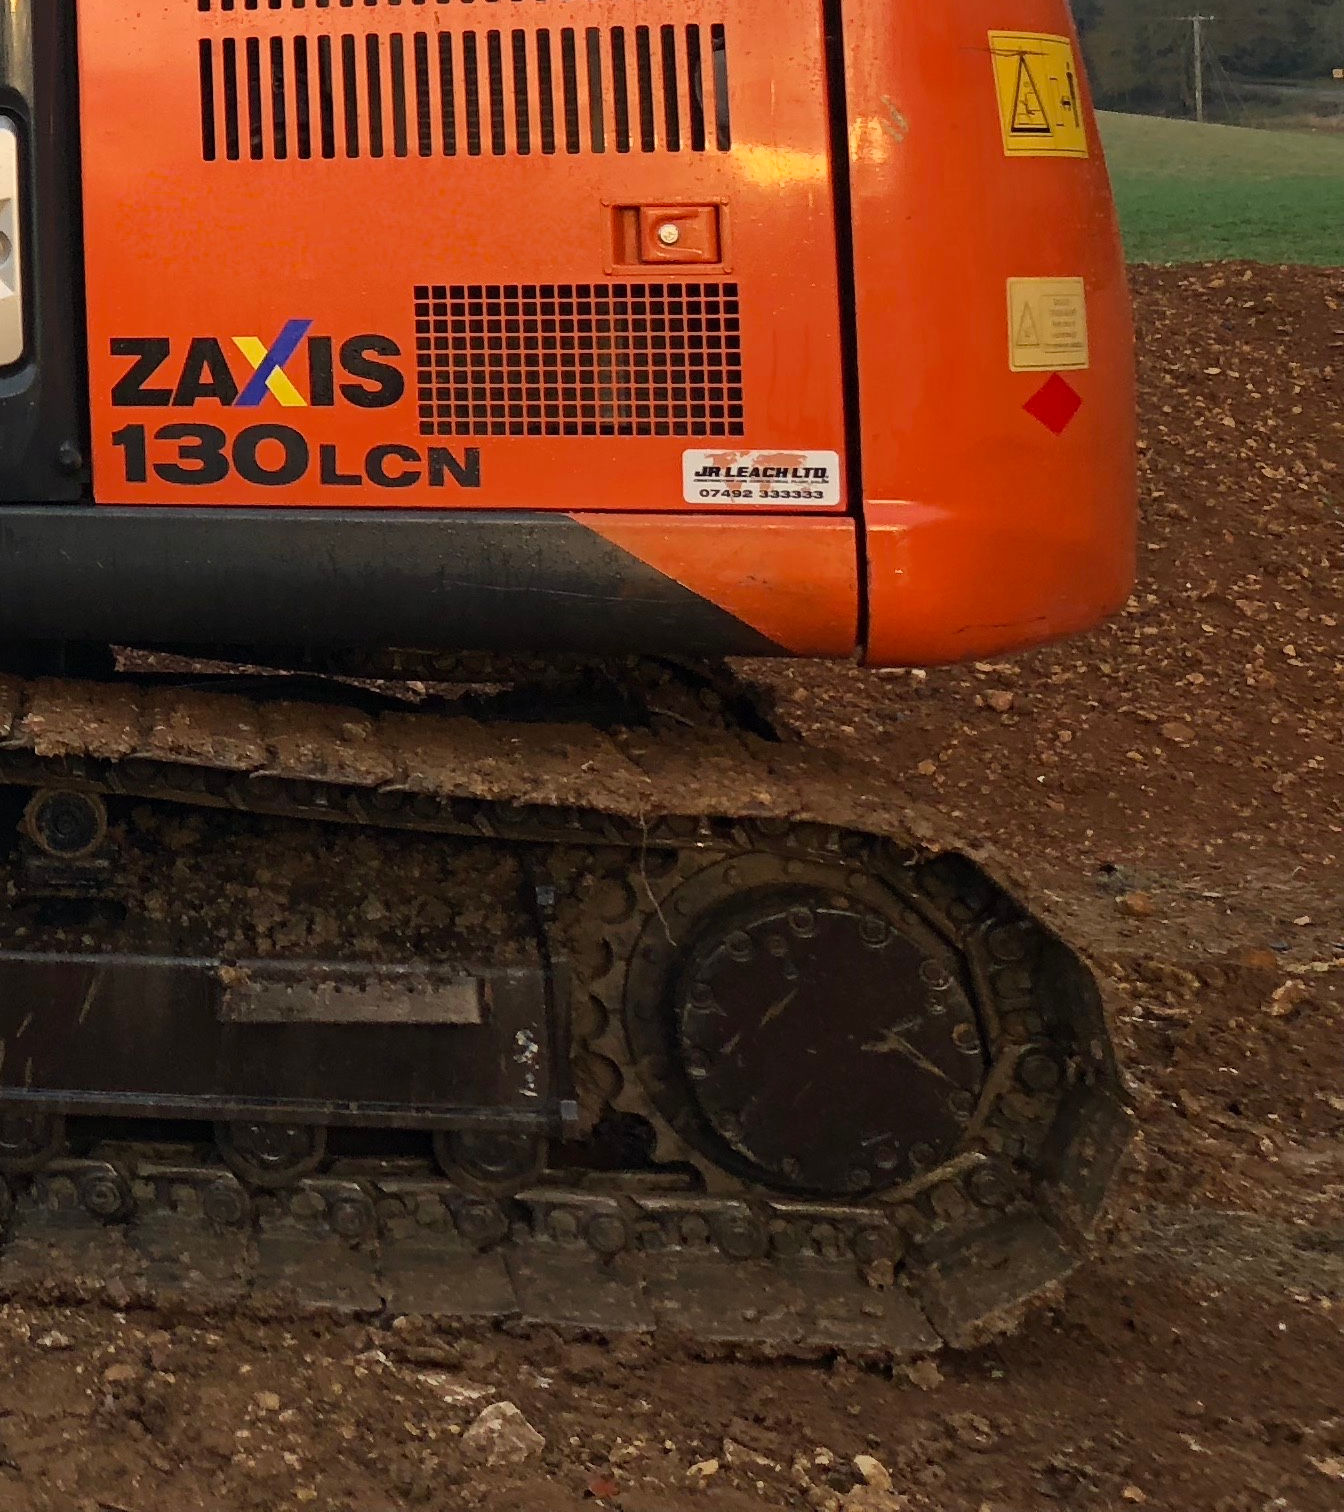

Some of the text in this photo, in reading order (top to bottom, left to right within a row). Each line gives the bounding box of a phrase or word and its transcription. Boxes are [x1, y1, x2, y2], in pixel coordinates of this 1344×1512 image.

[108, 319, 406, 408] ZAXIS
[695, 466, 721, 477] JR
[724, 466, 789, 478] LEACH
[699, 489, 824, 499] 07492 333333
